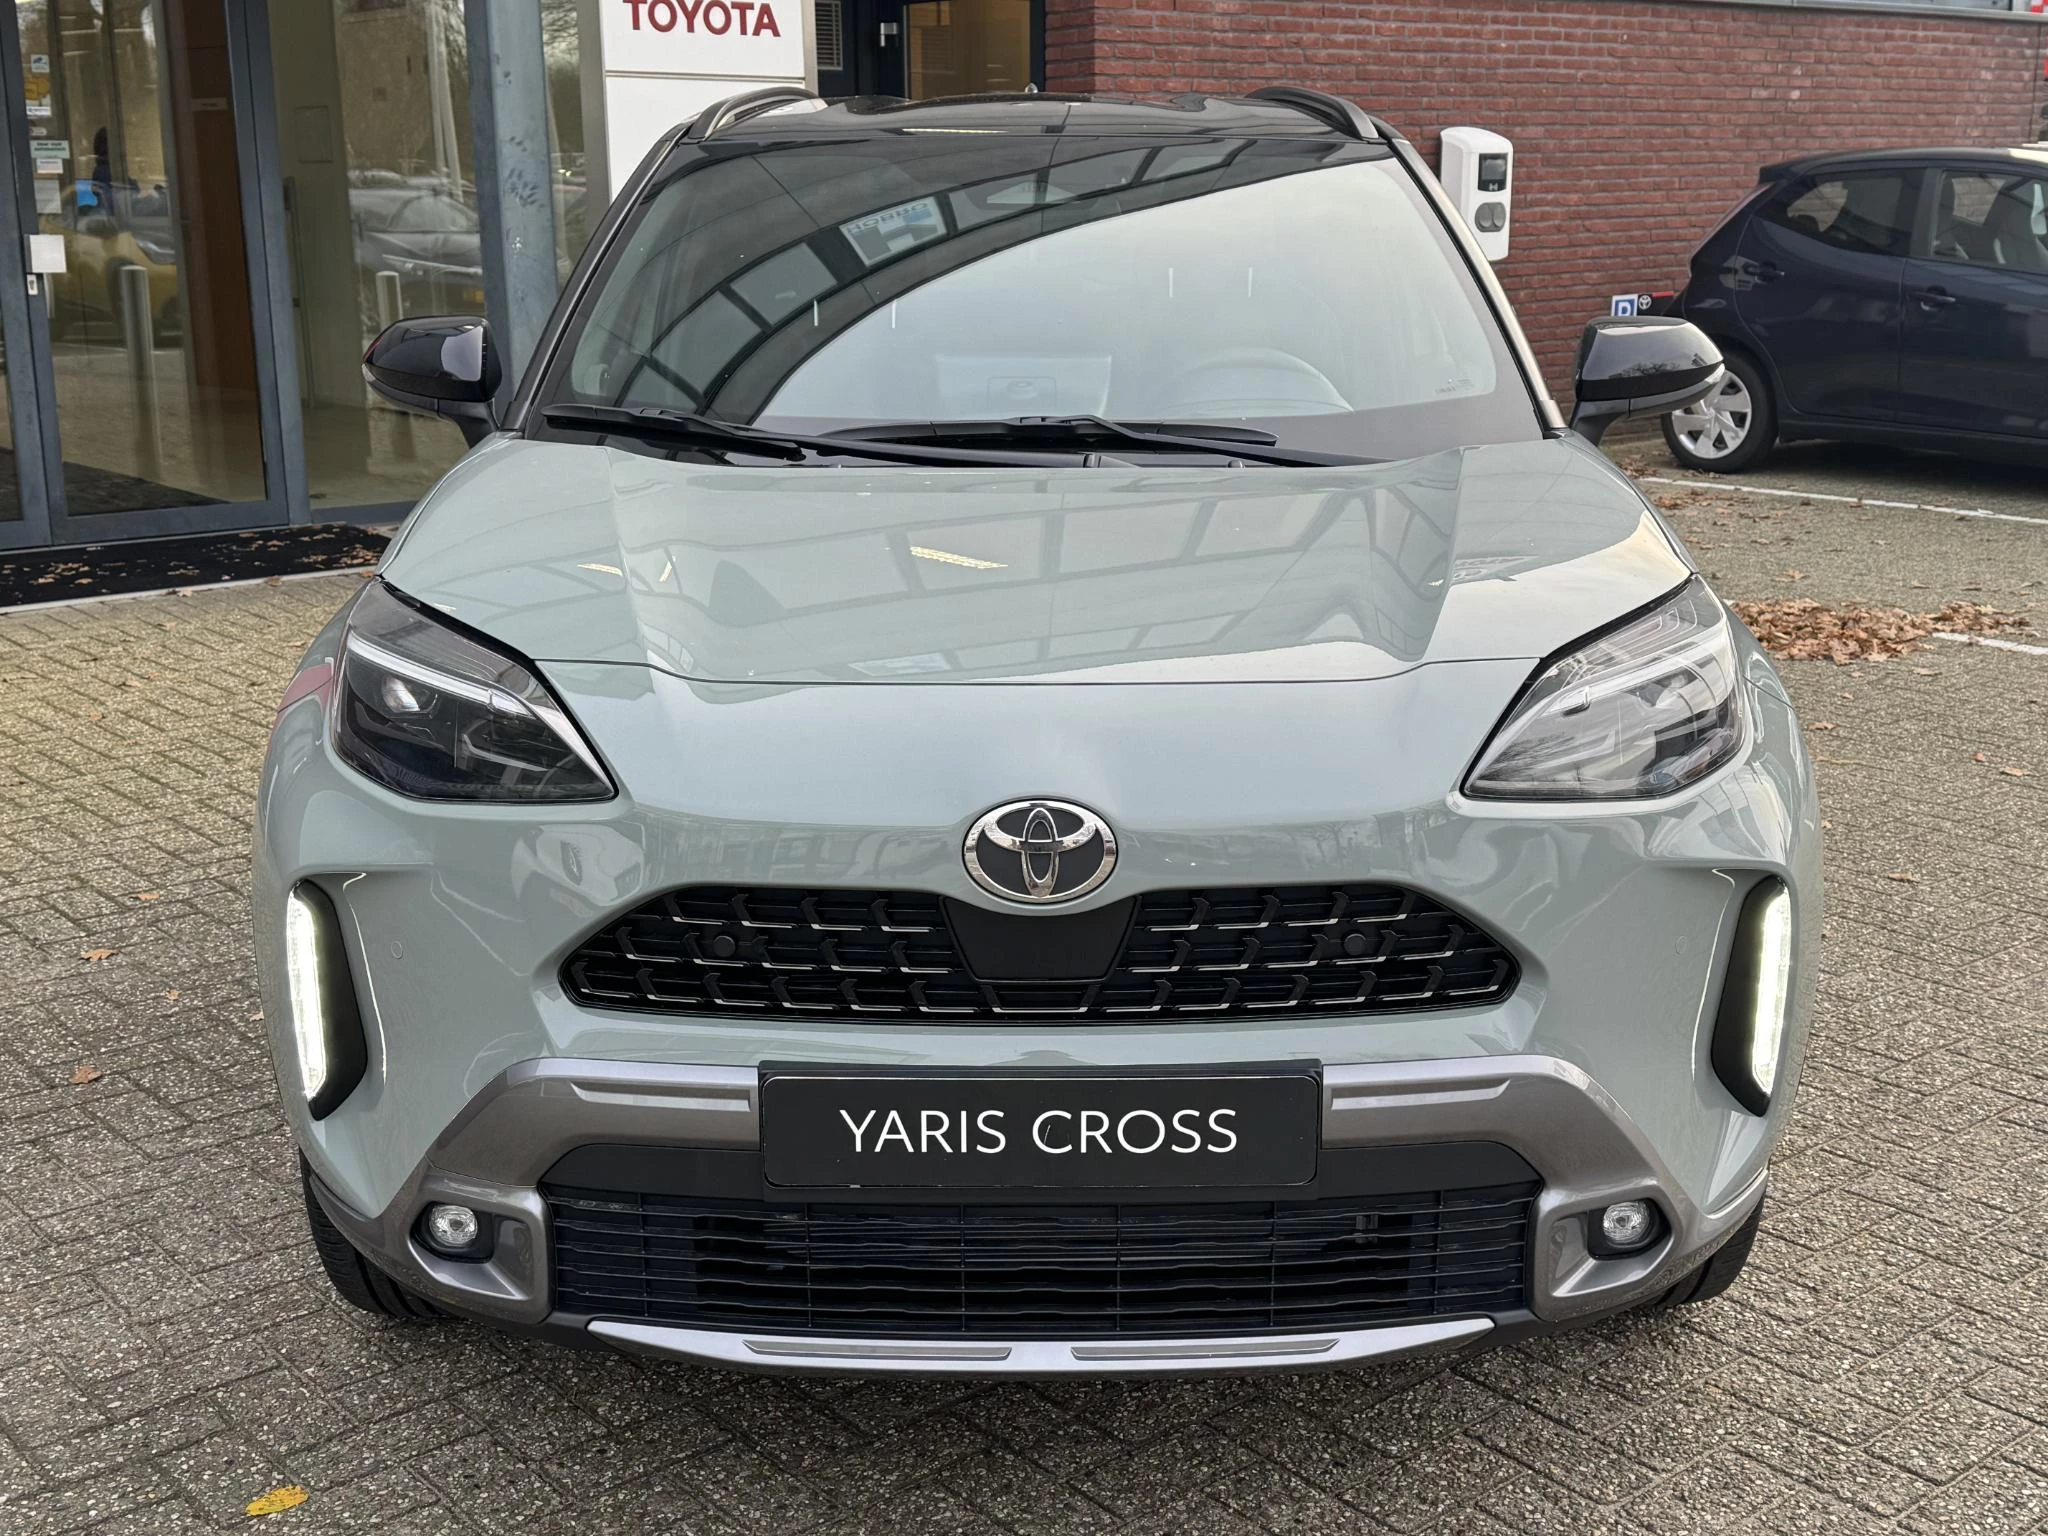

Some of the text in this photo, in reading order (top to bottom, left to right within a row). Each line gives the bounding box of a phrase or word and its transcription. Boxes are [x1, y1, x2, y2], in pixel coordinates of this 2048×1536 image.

[622, 0, 781, 38] TOYOTA
[839, 1108, 1238, 1154] YARIS CROSS
